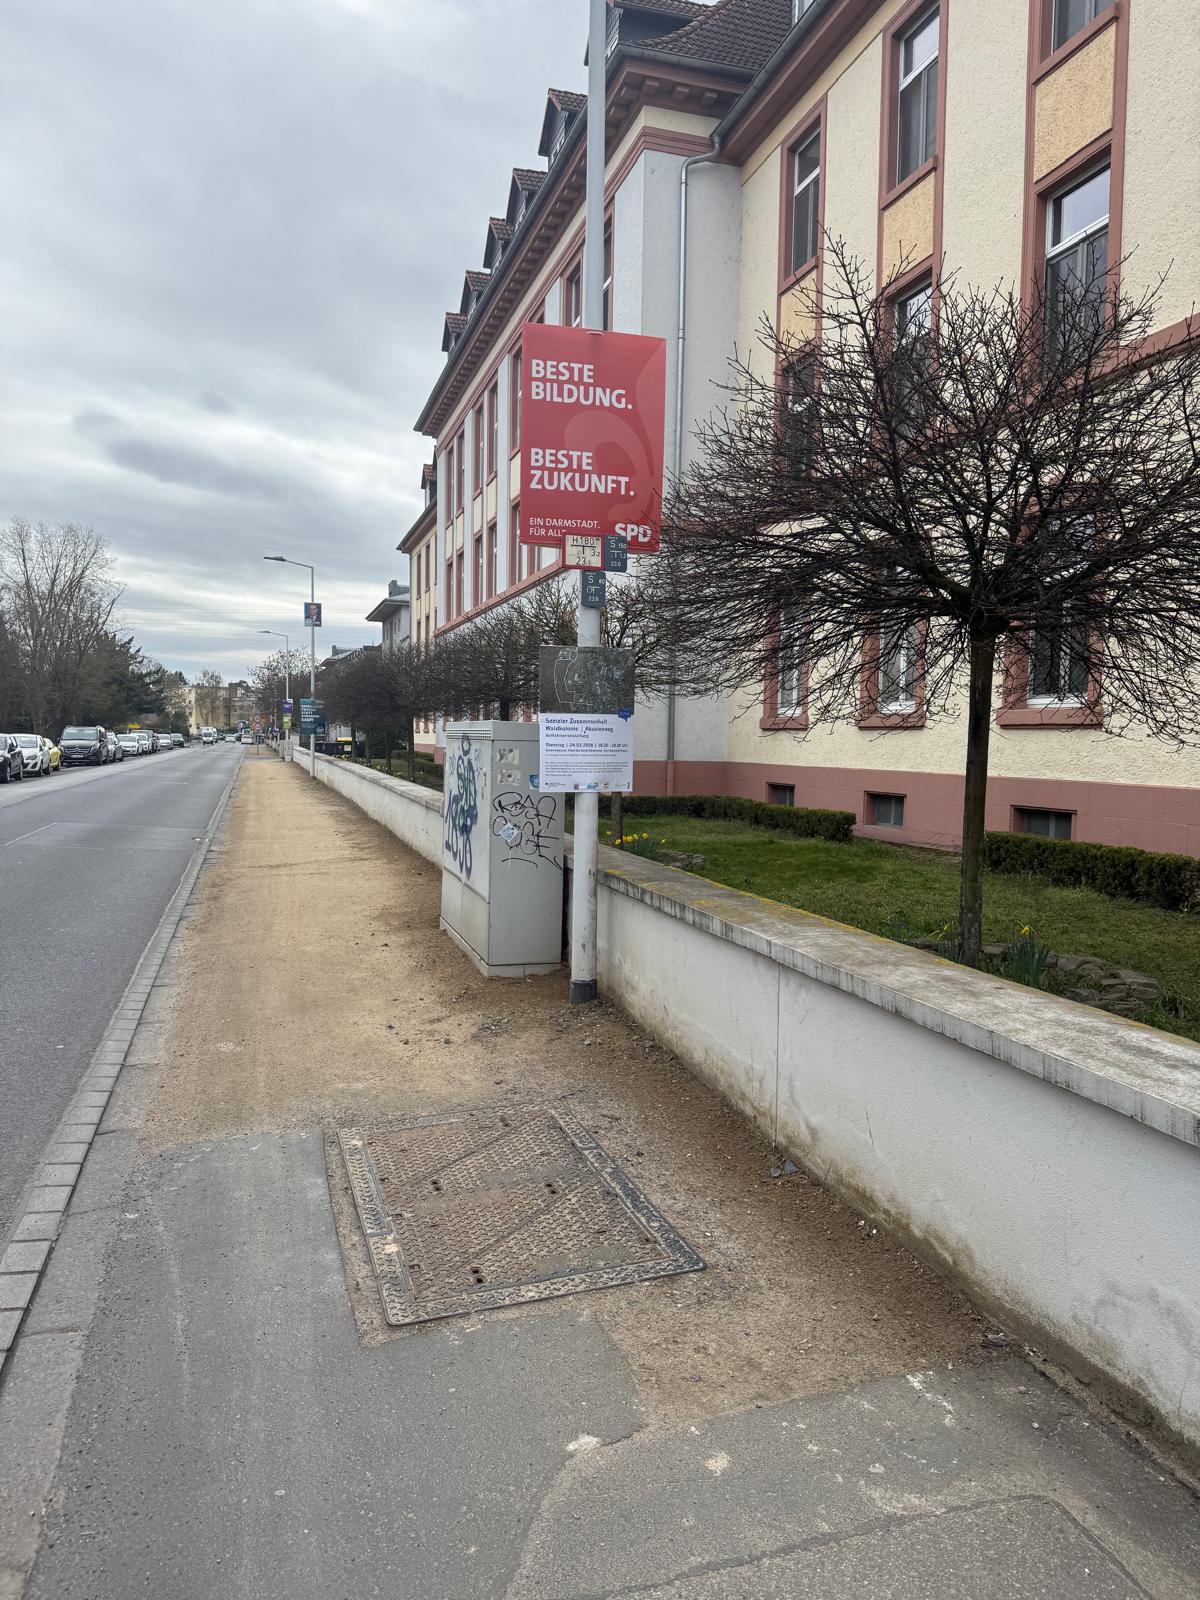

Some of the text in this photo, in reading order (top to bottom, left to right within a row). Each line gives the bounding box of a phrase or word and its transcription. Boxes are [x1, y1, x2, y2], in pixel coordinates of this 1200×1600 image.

[531, 359, 594, 383] BESTE
[531, 381, 633, 410] BILDUNG.
[530, 448, 593, 471] BESTE
[529, 470, 635, 497] ZUKUNFT.
[529, 517, 600, 530] EIN DARMSTADT.
[529, 526, 546, 537] FÜR
[615, 522, 652, 543] SPD
